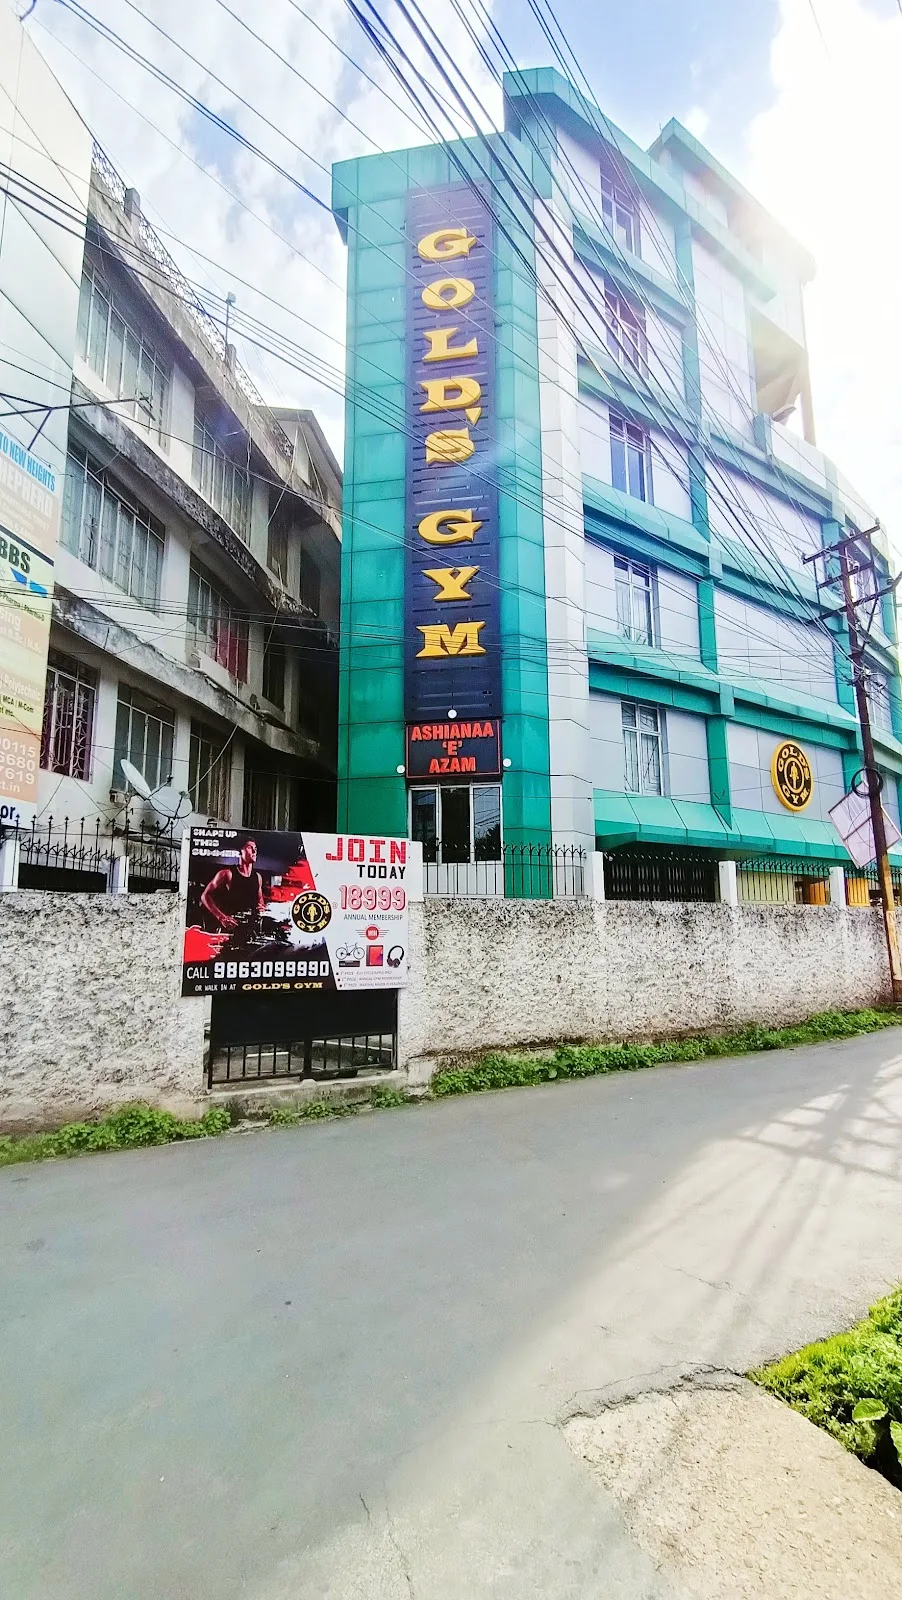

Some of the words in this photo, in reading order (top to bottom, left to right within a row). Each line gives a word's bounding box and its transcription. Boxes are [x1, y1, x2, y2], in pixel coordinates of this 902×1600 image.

[417, 227, 482, 465] GOLD'S
[10, 441, 26, 468] NEW
[27, 456, 56, 492] HEIGHTS
[415, 508, 487, 658] GYM
[411, 722, 494, 741] ASHIANAA
[429, 757, 476, 773] AZAM
[782, 784, 809, 804] GYM
[193, 828, 224, 838] SHAPE
[192, 838, 220, 847] THIS
[325, 837, 406, 864] JOIN
[191, 848, 241, 858] SUMMER
[357, 864, 406, 879] TODAY
[293, 893, 330, 914] GOLD'S
[339, 885, 406, 911] 18999
[296, 919, 328, 931] GYM
[186, 966, 209, 979] CALL
[213, 961, 329, 978] 9863099990
[205, 983, 218, 991] WALK
[229, 983, 236, 991] AT
[242, 982, 290, 990] GOLD'S
